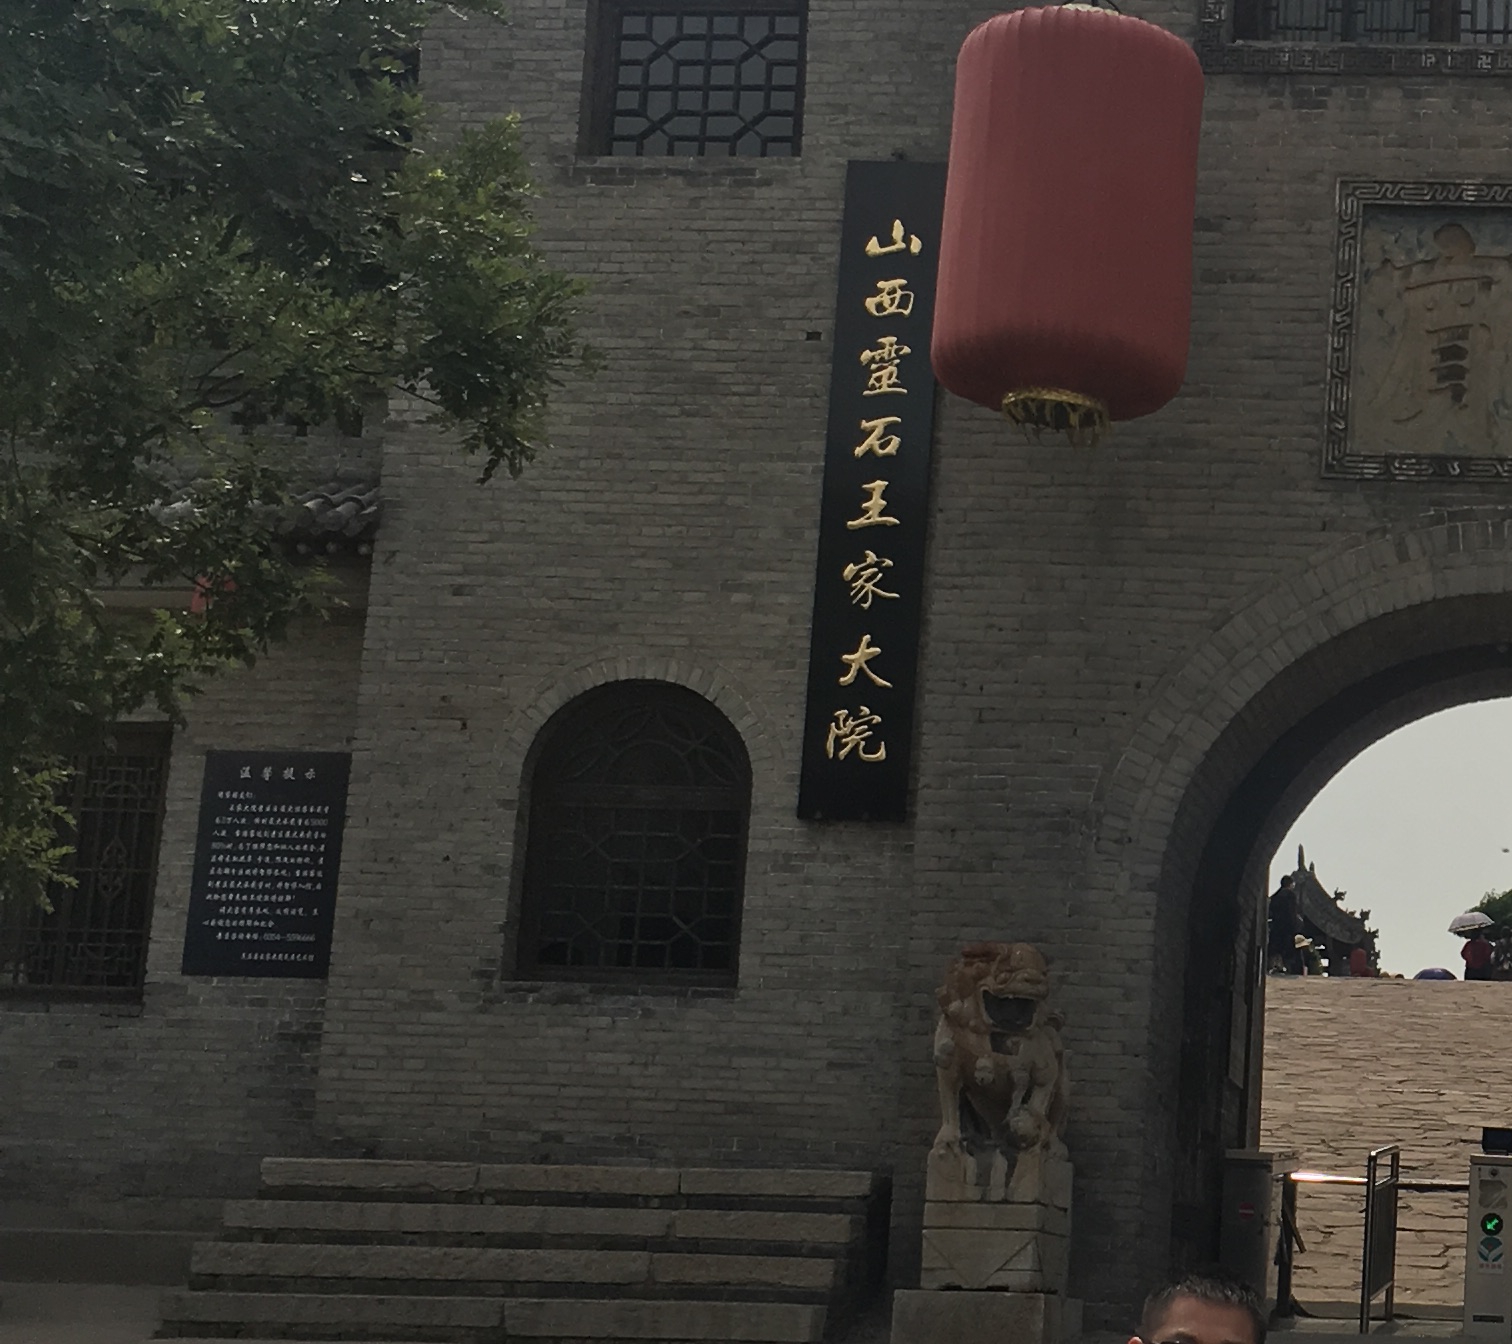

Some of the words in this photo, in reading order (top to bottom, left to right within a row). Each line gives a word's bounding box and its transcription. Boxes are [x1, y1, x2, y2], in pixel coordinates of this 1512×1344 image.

[824, 218, 923, 762] 山西靈石王家大院
